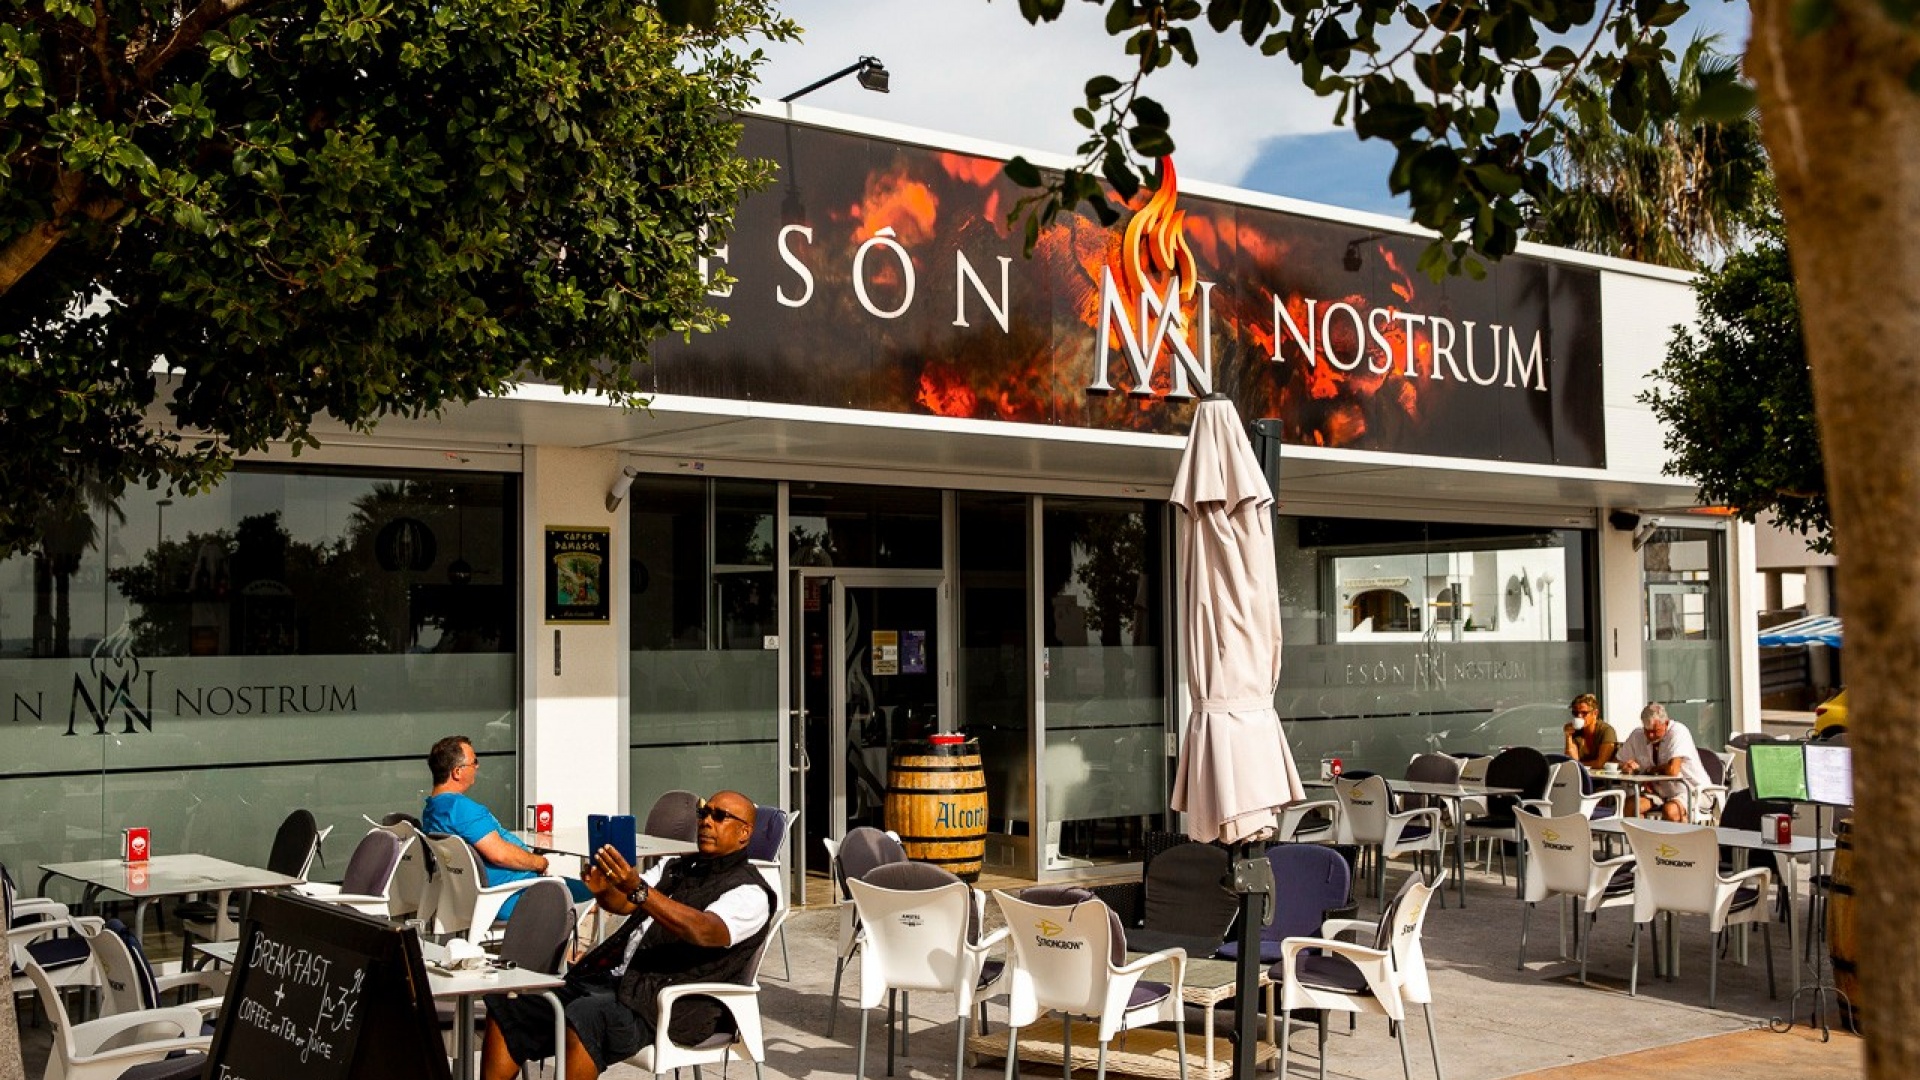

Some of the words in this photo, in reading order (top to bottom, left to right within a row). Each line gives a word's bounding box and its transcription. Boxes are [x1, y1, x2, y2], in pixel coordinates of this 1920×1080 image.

[697, 213, 1013, 334] ESÓN
[1271, 293, 1548, 391] NOSTRUM
[1453, 661, 1527, 680] NOSTRUM
[175, 684, 358, 717] NOSTRUM
[249, 930, 332, 987] BREAKFAST
[238, 997, 273, 1030] COFFEE
[278, 1016, 297, 1042] TEA
